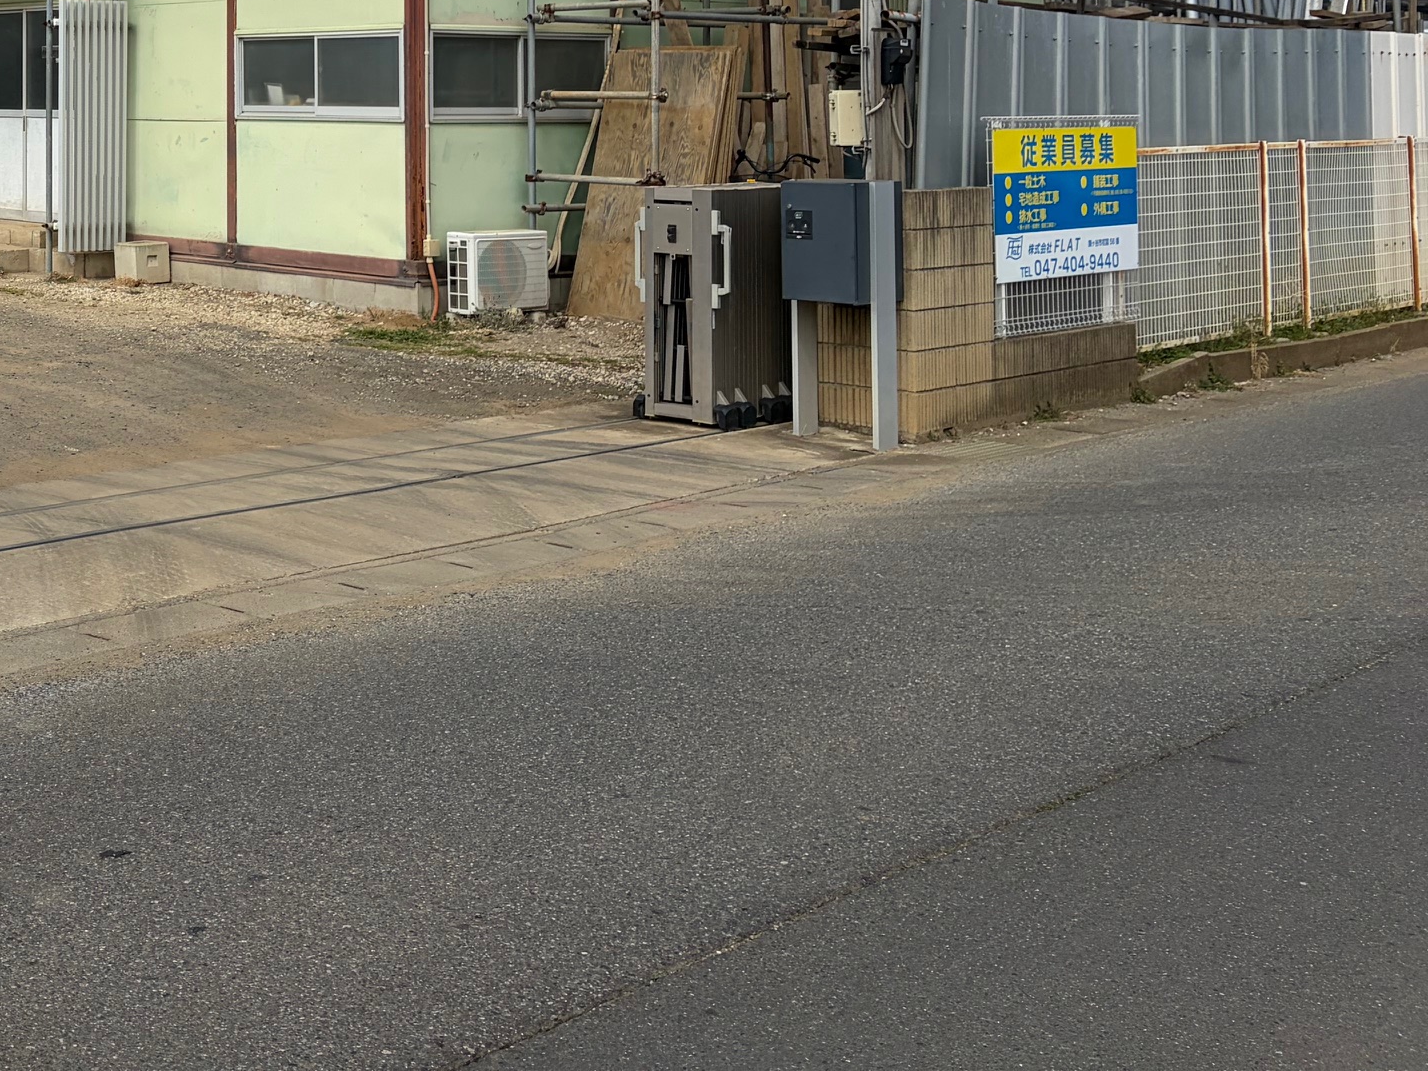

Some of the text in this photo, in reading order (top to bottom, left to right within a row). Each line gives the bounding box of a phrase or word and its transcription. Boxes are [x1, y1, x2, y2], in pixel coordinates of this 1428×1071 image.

[1021, 133, 1114, 168] 従業員募集
[1028, 237, 1081, 255] 株式会社 FLAT
[1020, 266, 1033, 278] TEL
